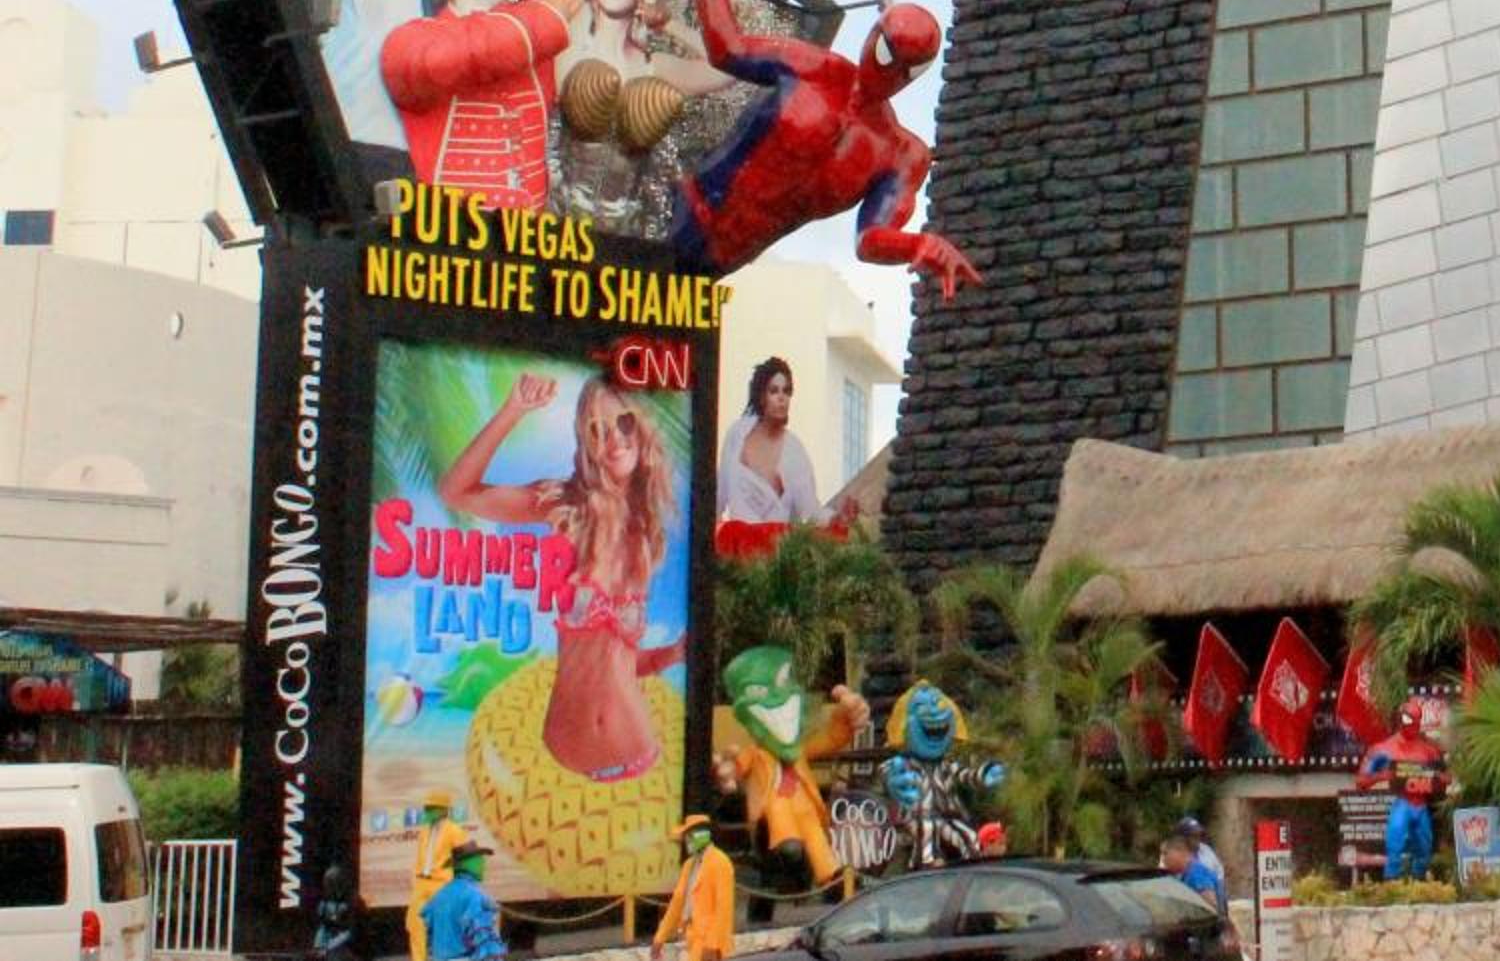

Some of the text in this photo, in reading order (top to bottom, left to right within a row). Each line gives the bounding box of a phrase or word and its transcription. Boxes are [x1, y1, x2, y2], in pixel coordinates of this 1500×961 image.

[390, 178, 596, 263] PUTS VEGAS
[366, 245, 536, 313] NIGHTLIFE
[551, 268, 591, 319] TO
[619, 343, 690, 390] CNN
[373, 498, 578, 615] SUMMER
[414, 576, 533, 654] LAND
